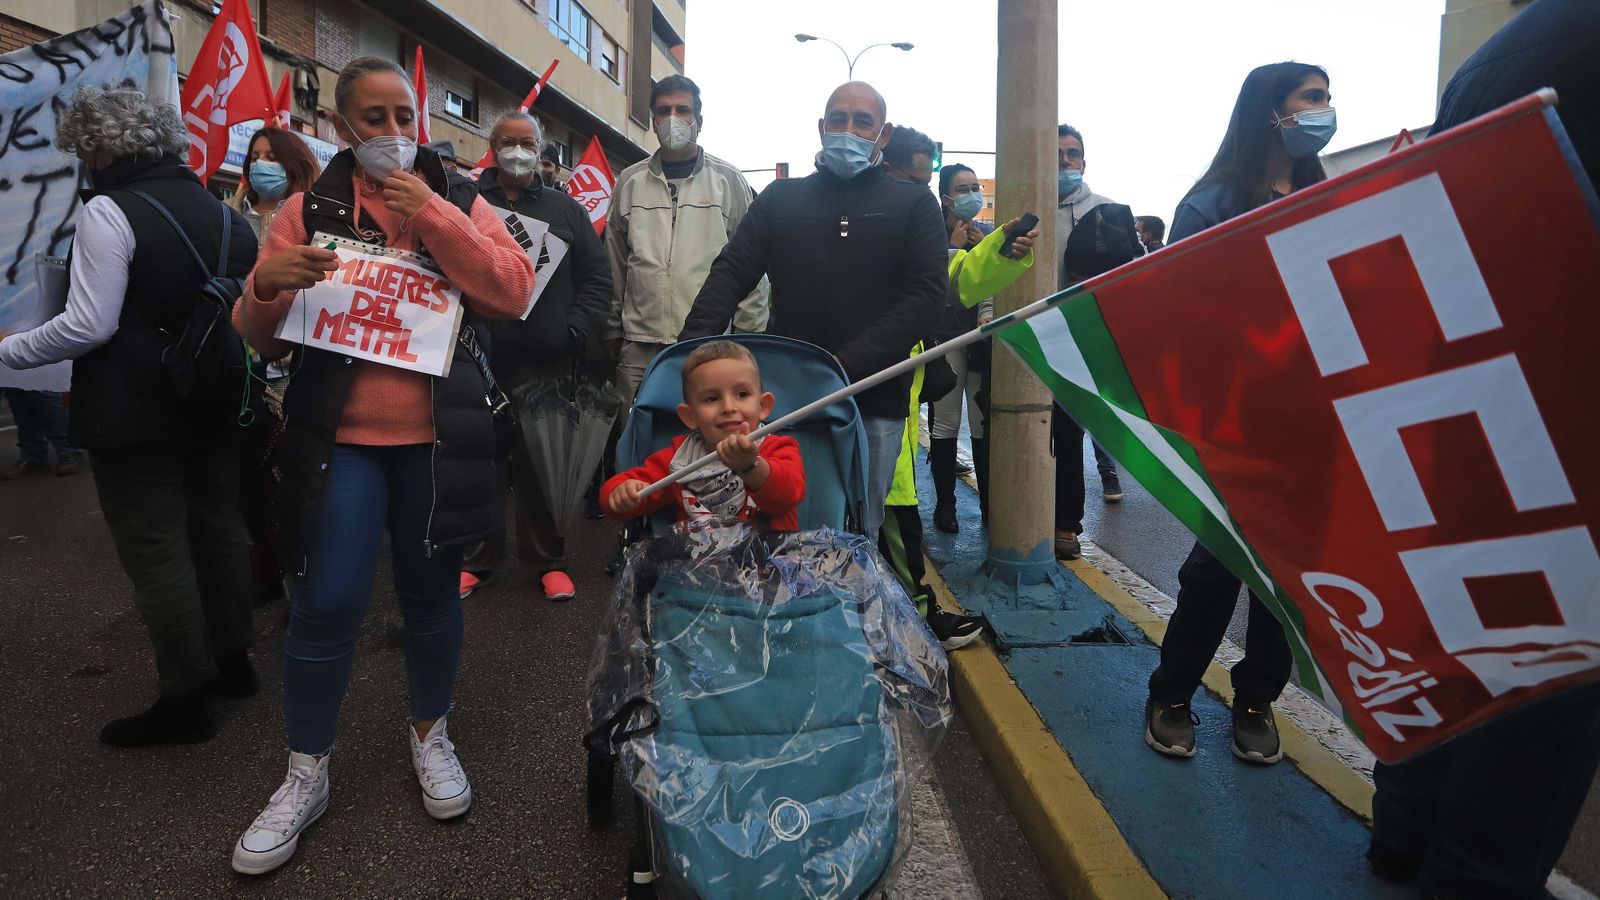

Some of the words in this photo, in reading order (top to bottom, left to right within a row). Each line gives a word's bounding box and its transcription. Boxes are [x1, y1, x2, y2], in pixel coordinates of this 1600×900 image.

[325, 255, 452, 314] MUJERES
[349, 290, 403, 326] DEL
[312, 307, 418, 363] METAL
[1300, 571, 1444, 743] Cádiz
